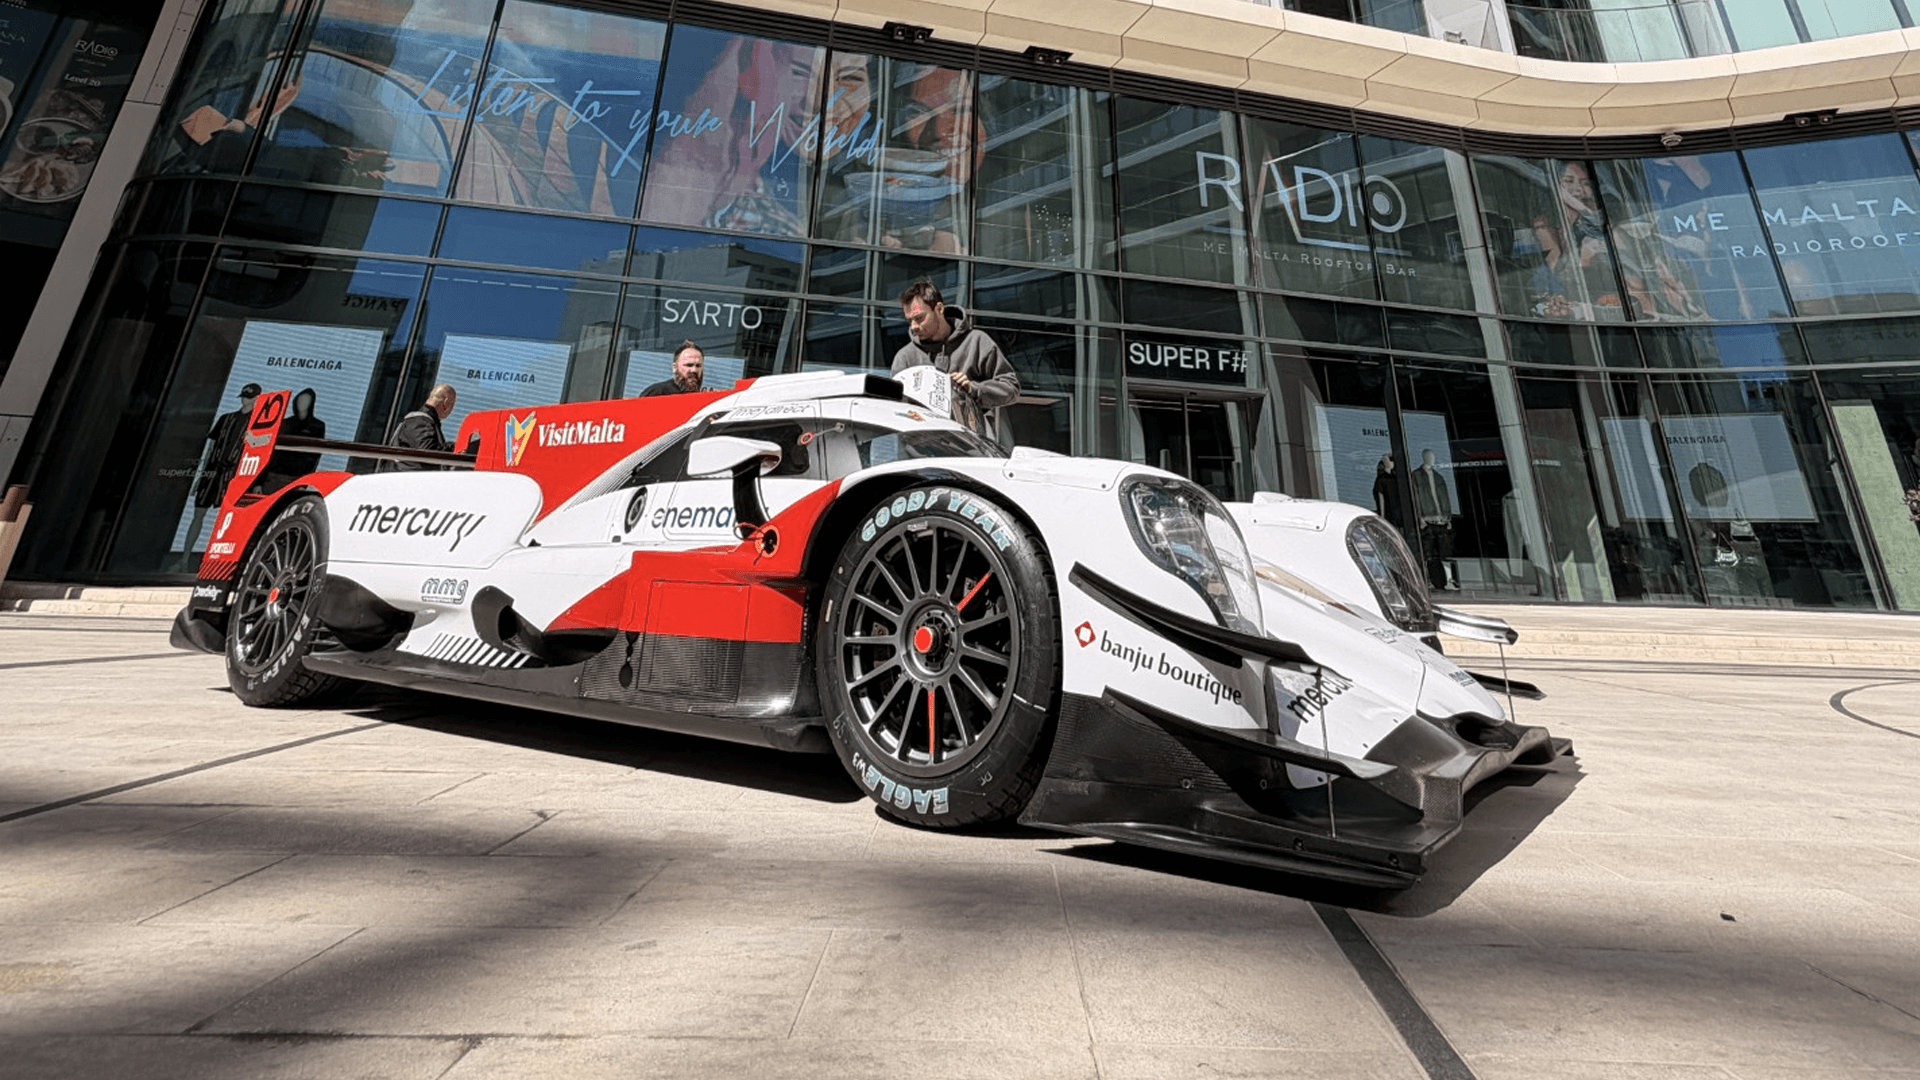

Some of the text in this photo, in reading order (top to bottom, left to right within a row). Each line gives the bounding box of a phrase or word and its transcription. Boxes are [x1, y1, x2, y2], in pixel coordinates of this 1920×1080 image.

[408, 49, 887, 178] Listen to your World
[1195, 150, 1408, 243] RADIO
[1673, 196, 1917, 233] ME MALTA
[1731, 229, 1920, 258] RADIOROOF
[1386, 262, 1418, 278] BAR
[661, 298, 763, 330] SARTO
[266, 356, 344, 371] BALENCIAGA
[1128, 341, 1210, 371] SUPER
[466, 368, 536, 385] BALENCIAGA
[537, 418, 626, 448] VisitMalta
[1665, 435, 1727, 445] BALENCIAGA
[349, 502, 488, 553] mercury
[421, 577, 470, 604] mmg
[1101, 630, 1242, 706] banju boutique
[862, 764, 950, 815] EAGLE
